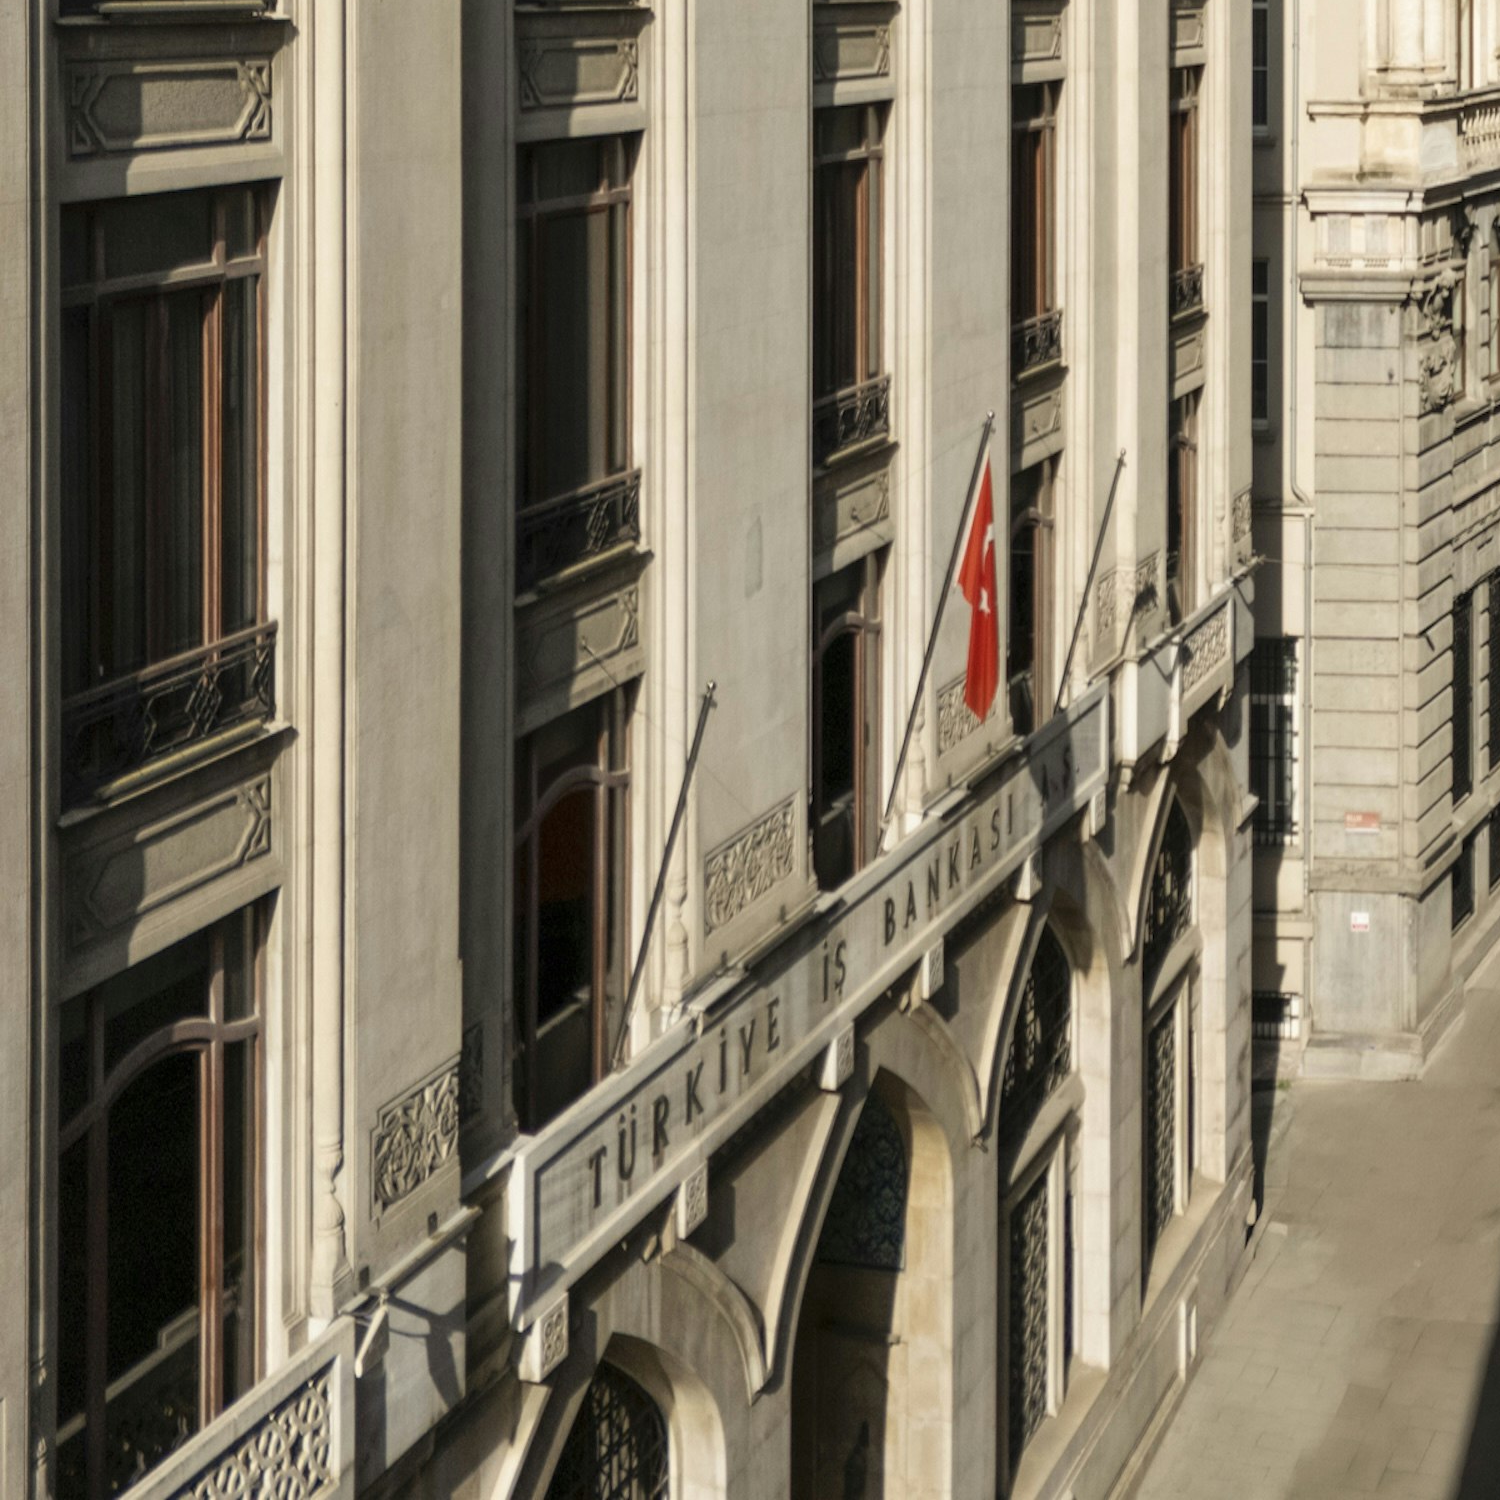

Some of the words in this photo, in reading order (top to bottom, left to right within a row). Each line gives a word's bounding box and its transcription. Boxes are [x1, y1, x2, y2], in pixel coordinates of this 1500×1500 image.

[588, 996, 781, 1209] TÜRKİYE
[822, 938, 847, 1003] İŞ
[884, 792, 1013, 947] BANKASI
